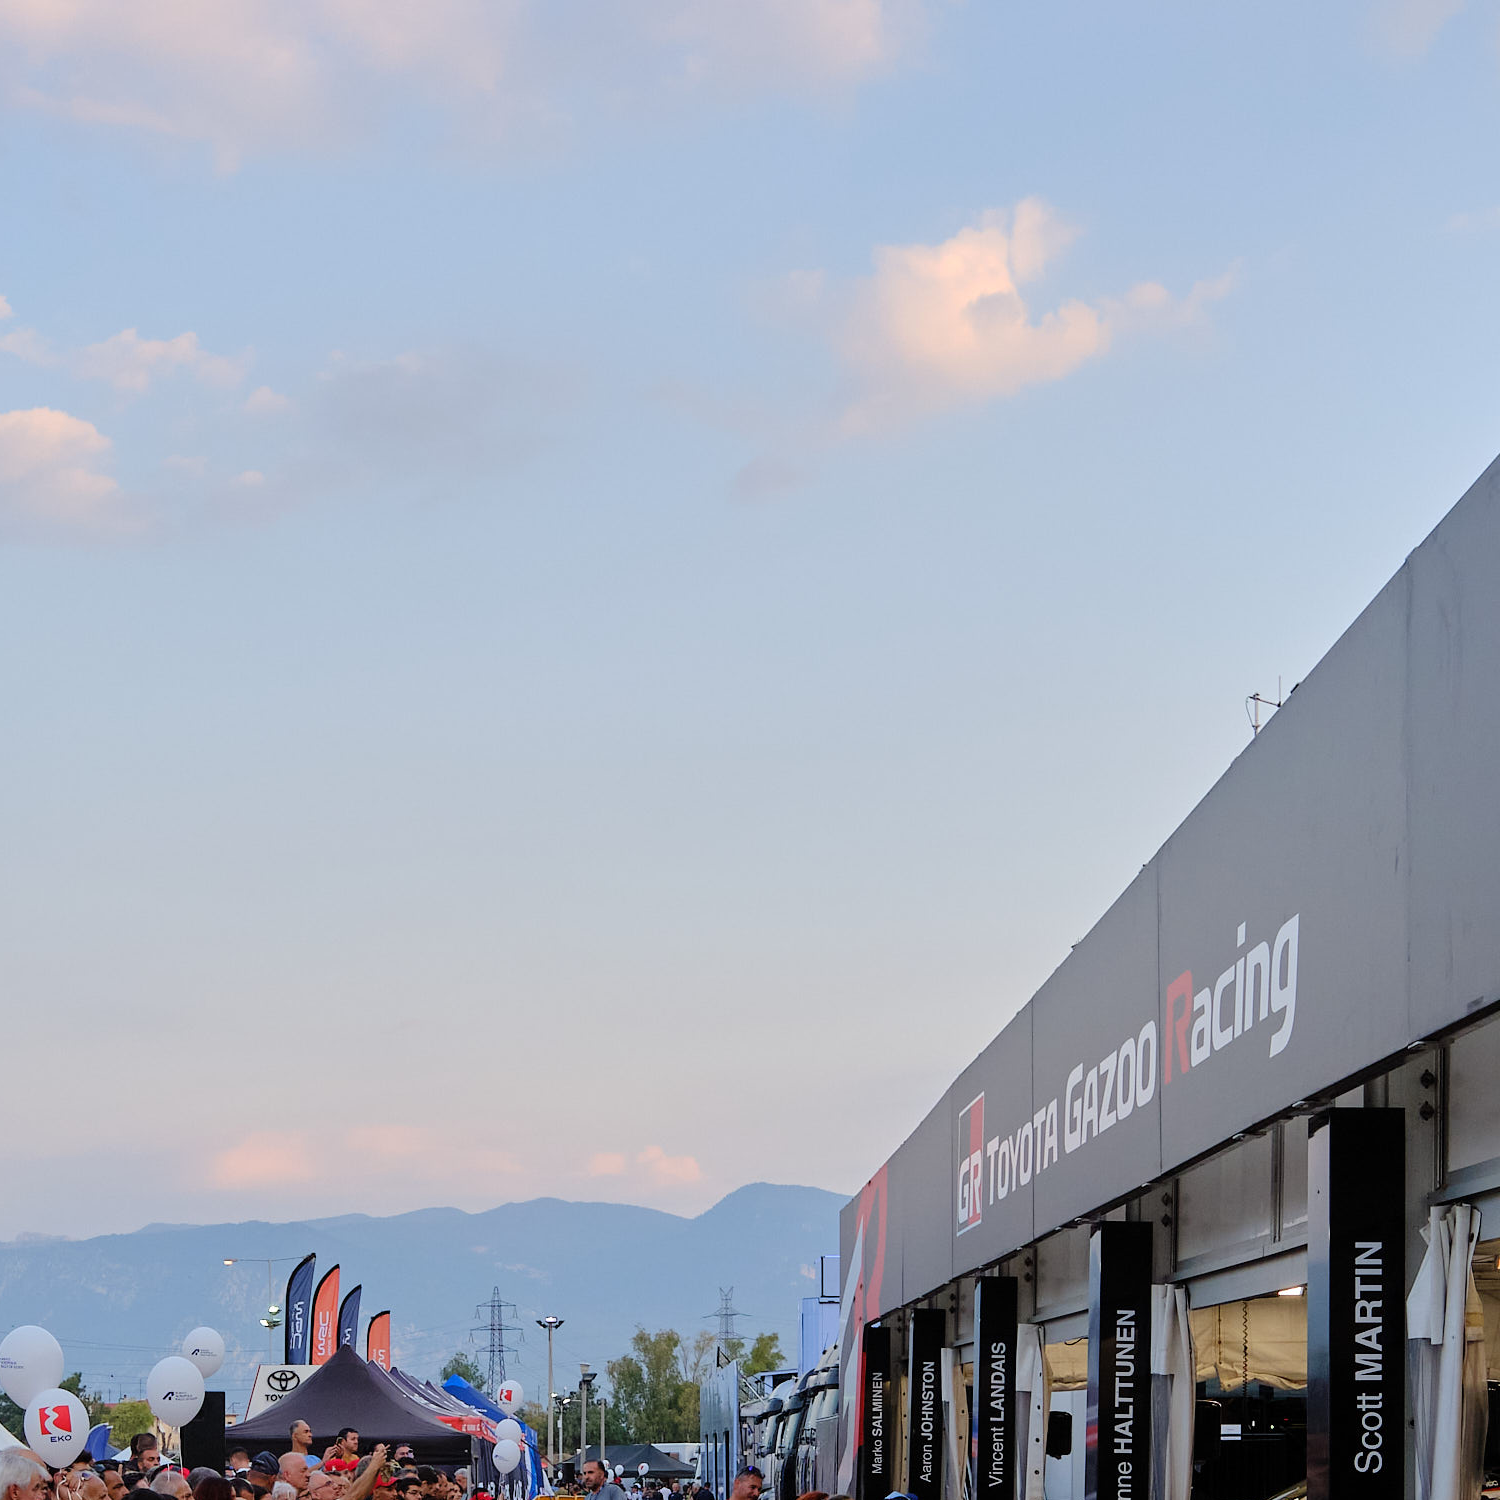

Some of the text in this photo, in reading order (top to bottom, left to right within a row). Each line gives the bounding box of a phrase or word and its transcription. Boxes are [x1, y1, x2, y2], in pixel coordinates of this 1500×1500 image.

[958, 912, 1300, 1226] GR TOYOTA GAZOO Racing
[871, 1372, 883, 1474] Marko SALMINEN
[920, 1361, 935, 1483] Aaron JOHNSTON
[988, 1342, 1006, 1487] Vincent LANDAIS
[1113, 1308, 1136, 1455] HALTTUNEN
[1354, 1240, 1384, 1475] Scott MARTIN
[50, 1434, 72, 1443] EKO
